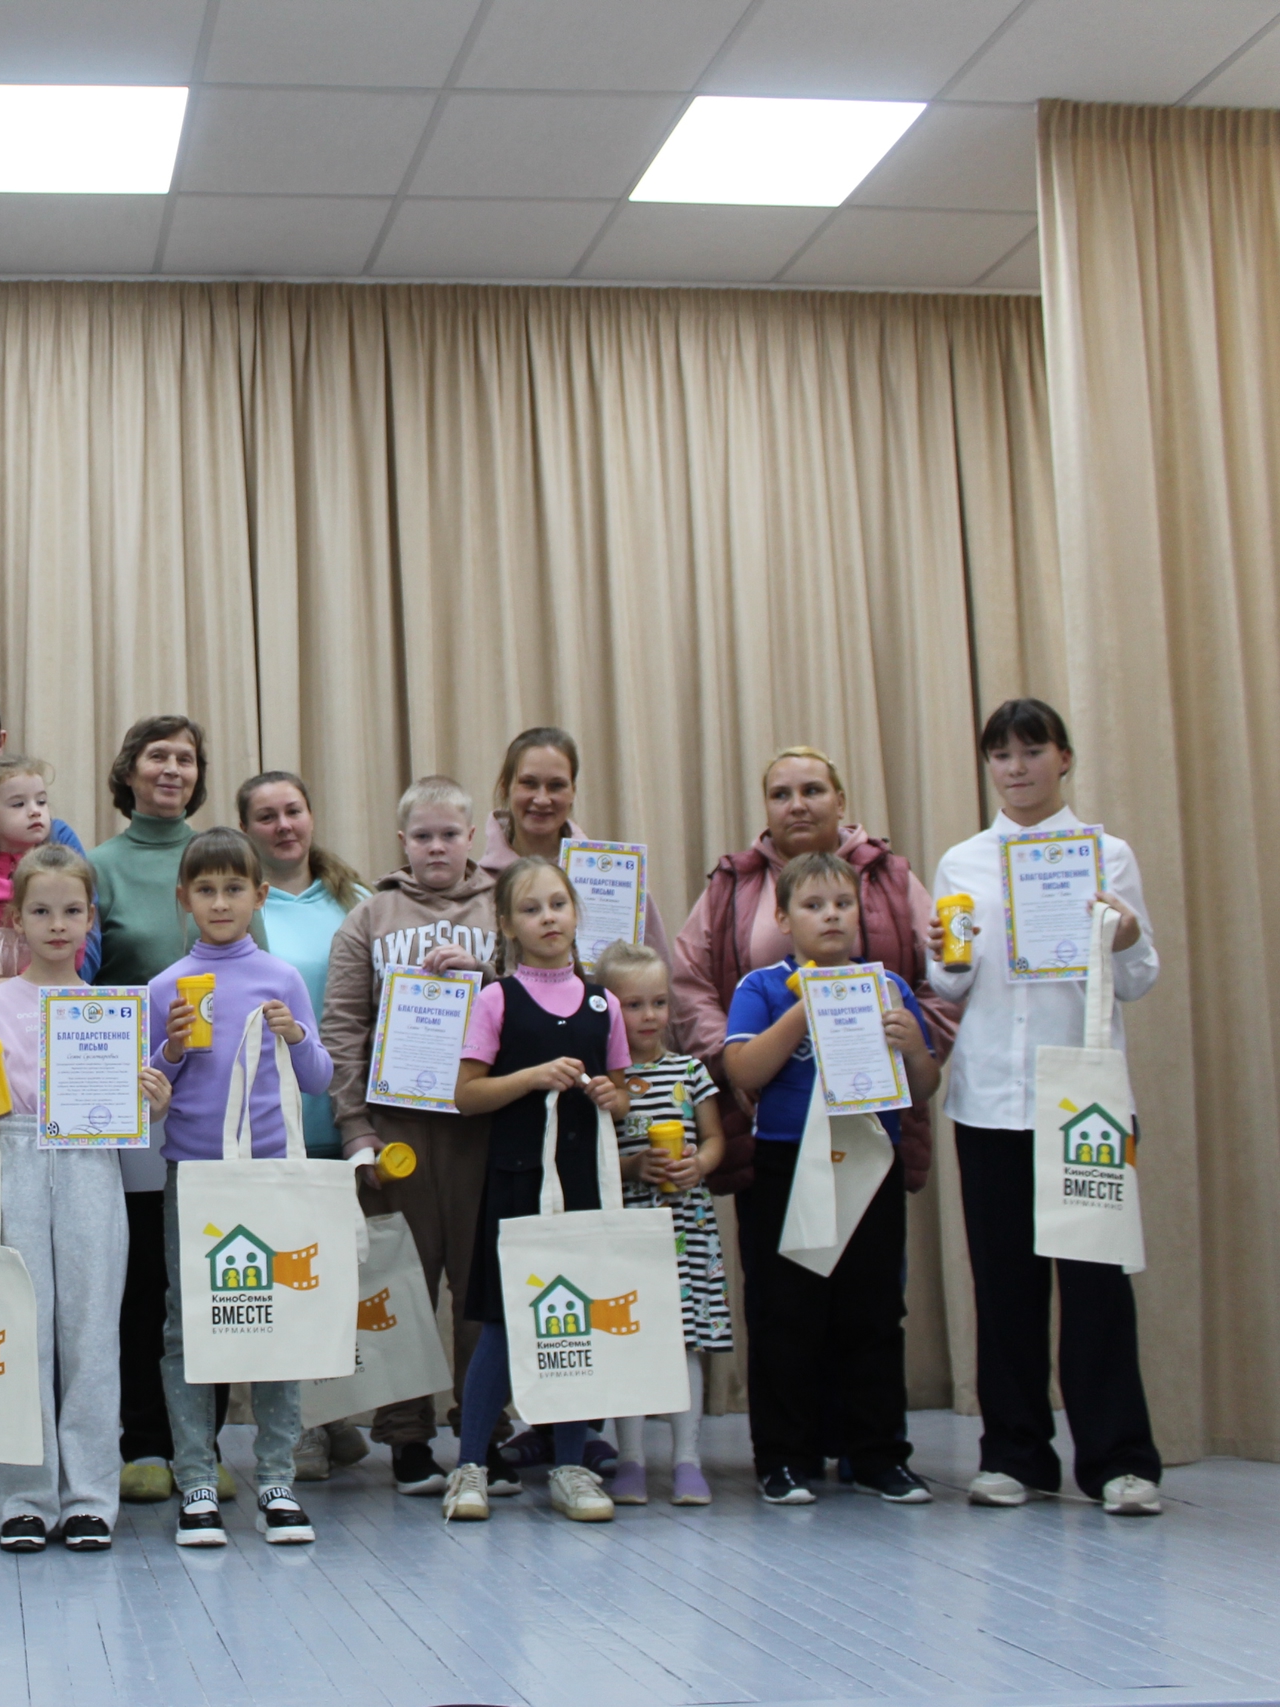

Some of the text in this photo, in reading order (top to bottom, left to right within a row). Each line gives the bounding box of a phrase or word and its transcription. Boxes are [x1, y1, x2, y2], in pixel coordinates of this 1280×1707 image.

[372, 919, 497, 981] AWESOM
[398, 1004, 461, 1018] БЛАГОДАРСТВЕННОЕ
[415, 1015, 441, 1026] ПИСЬМО
[57, 1032, 131, 1041] БЛАГОДАРСТВЕННОЕ
[78, 1042, 108, 1051] ПИСЬМО
[1064, 1178, 1124, 1202] ВМЕСТЕ
[212, 1294, 273, 1303] КиноСемья
[212, 1305, 273, 1325] ВМЕСТЕ
[212, 1326, 274, 1335] БУРМАКИНО
[537, 1340, 591, 1349] КиноСемья
[537, 1349, 593, 1370] ВМЕСТЕ
